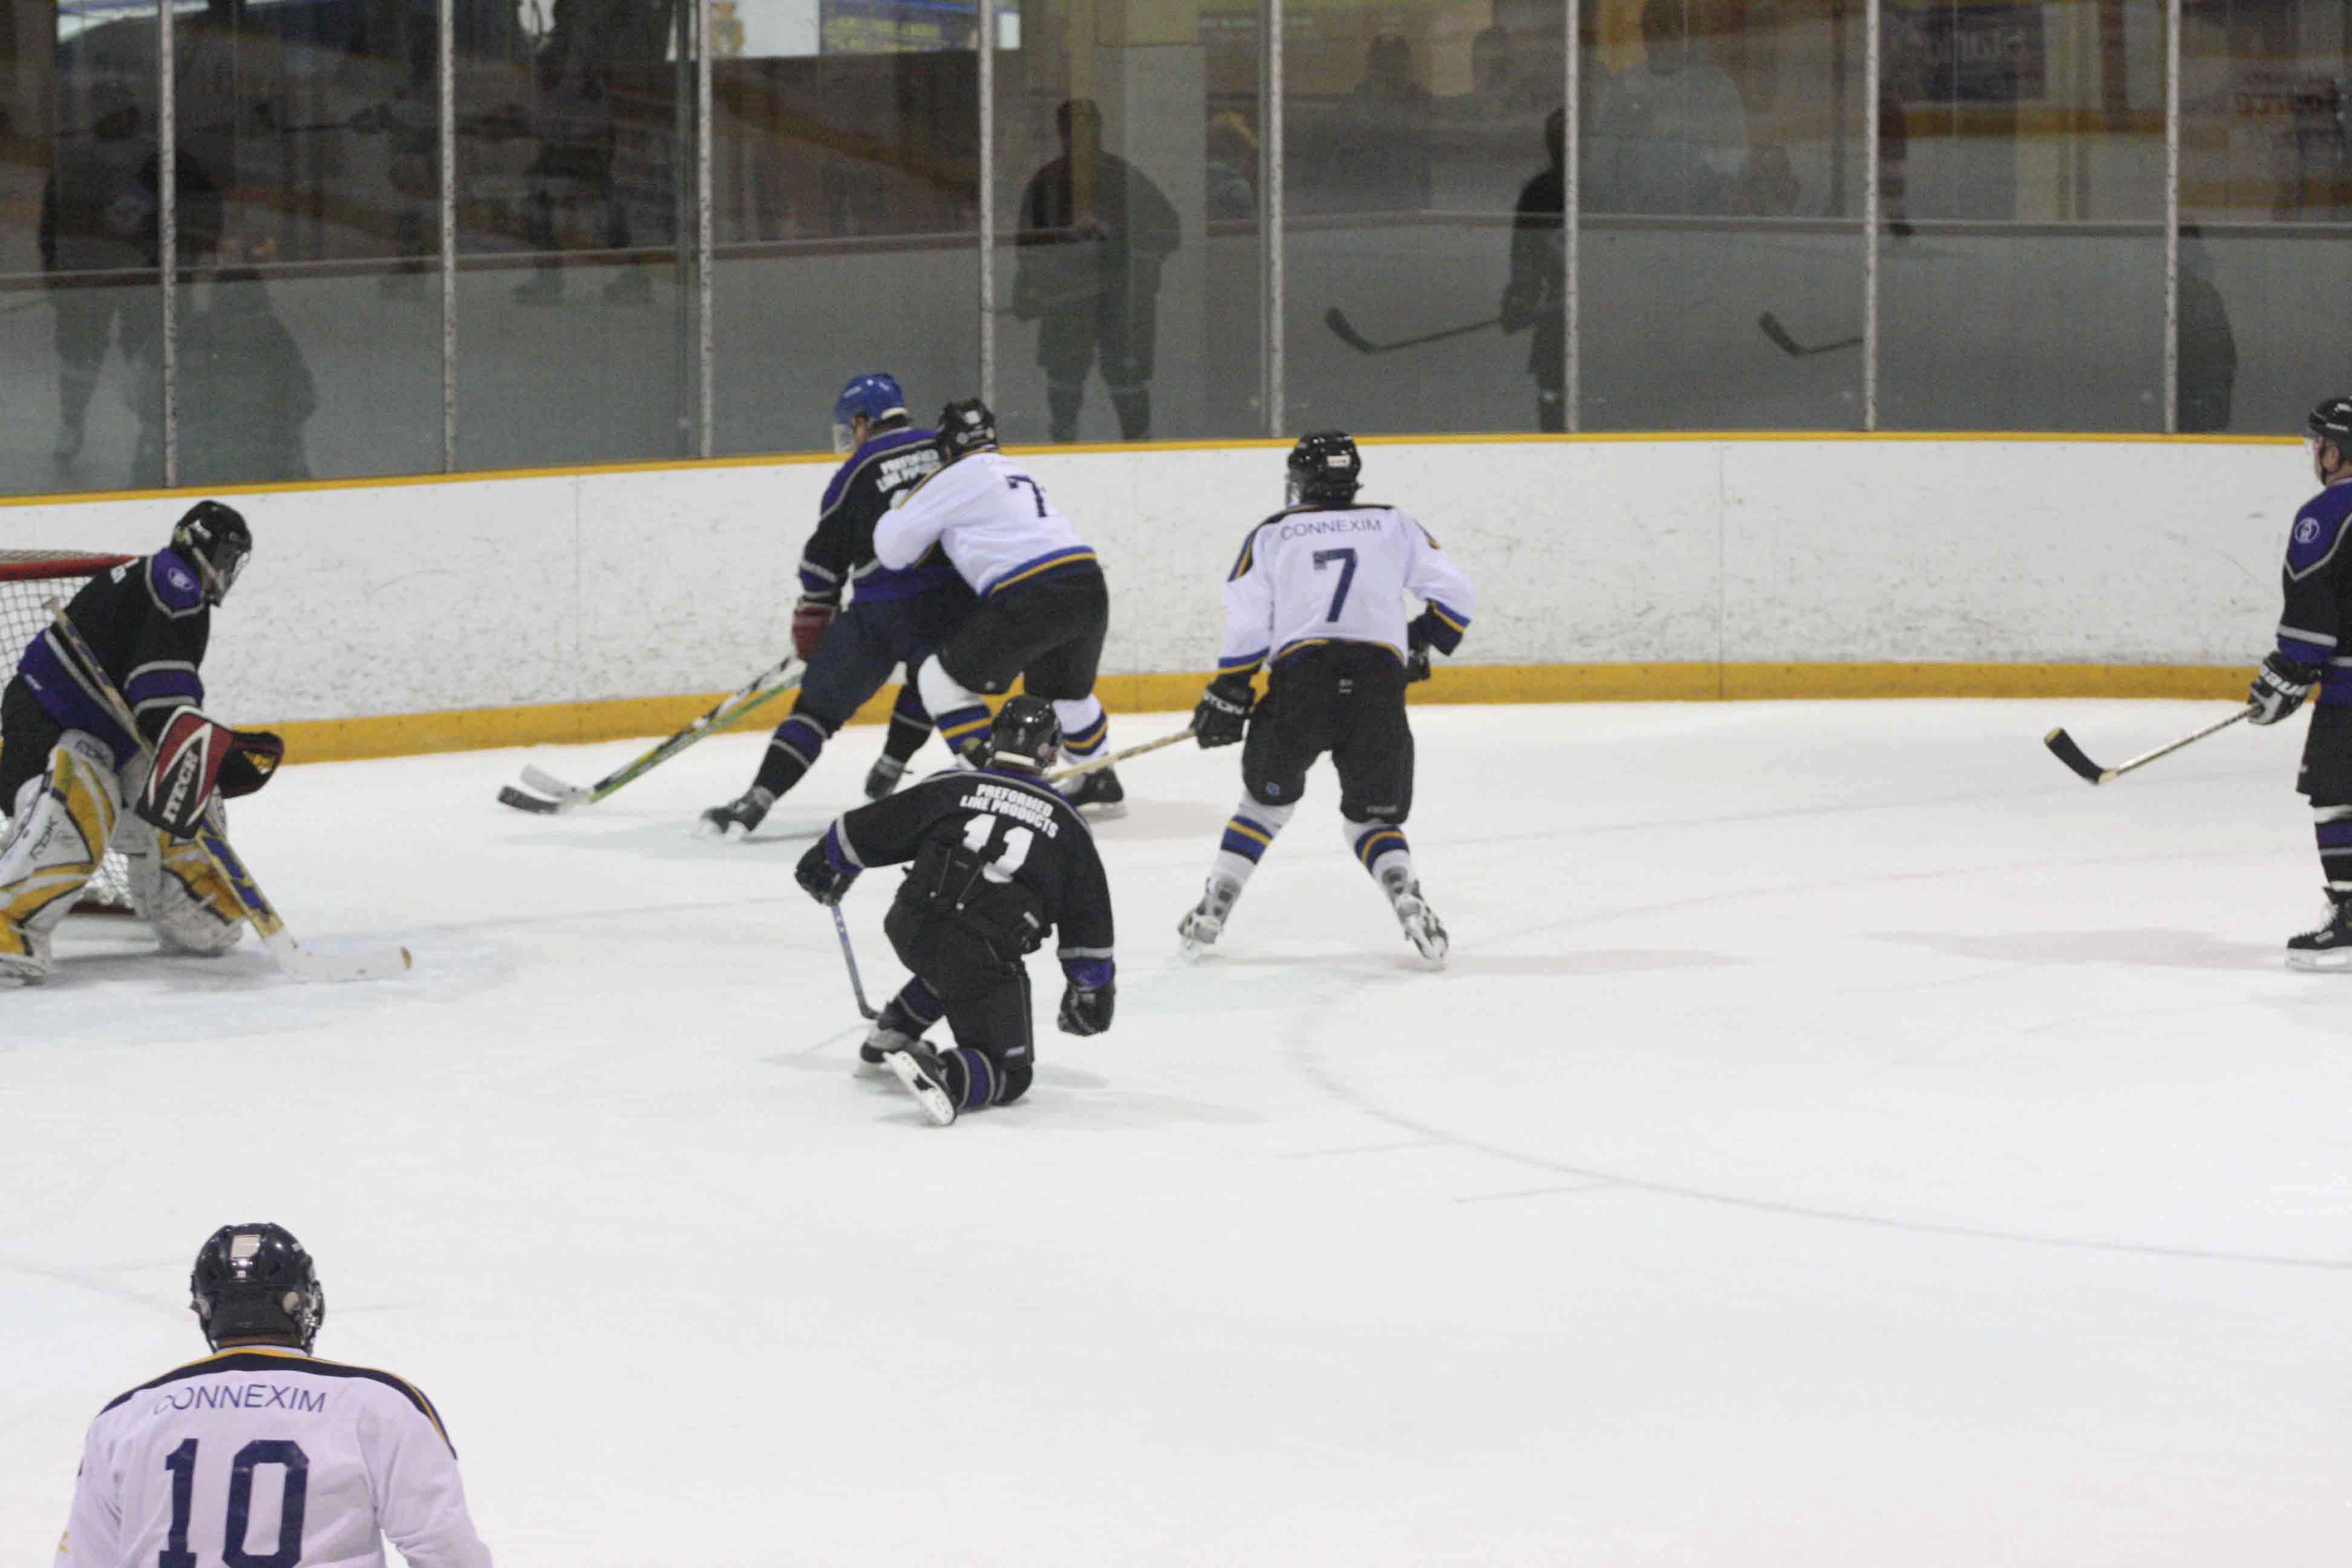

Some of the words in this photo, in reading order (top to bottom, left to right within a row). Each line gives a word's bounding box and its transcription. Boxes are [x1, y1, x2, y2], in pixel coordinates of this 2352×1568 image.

[1005, 474, 1047, 518] 7
[1280, 519, 1383, 541] CONNEXIM
[1312, 547, 1358, 622] 7
[975, 783, 1053, 817] PREFORMED
[990, 799, 1059, 838] PRODUCTS
[158, 1438, 309, 1568] 10
